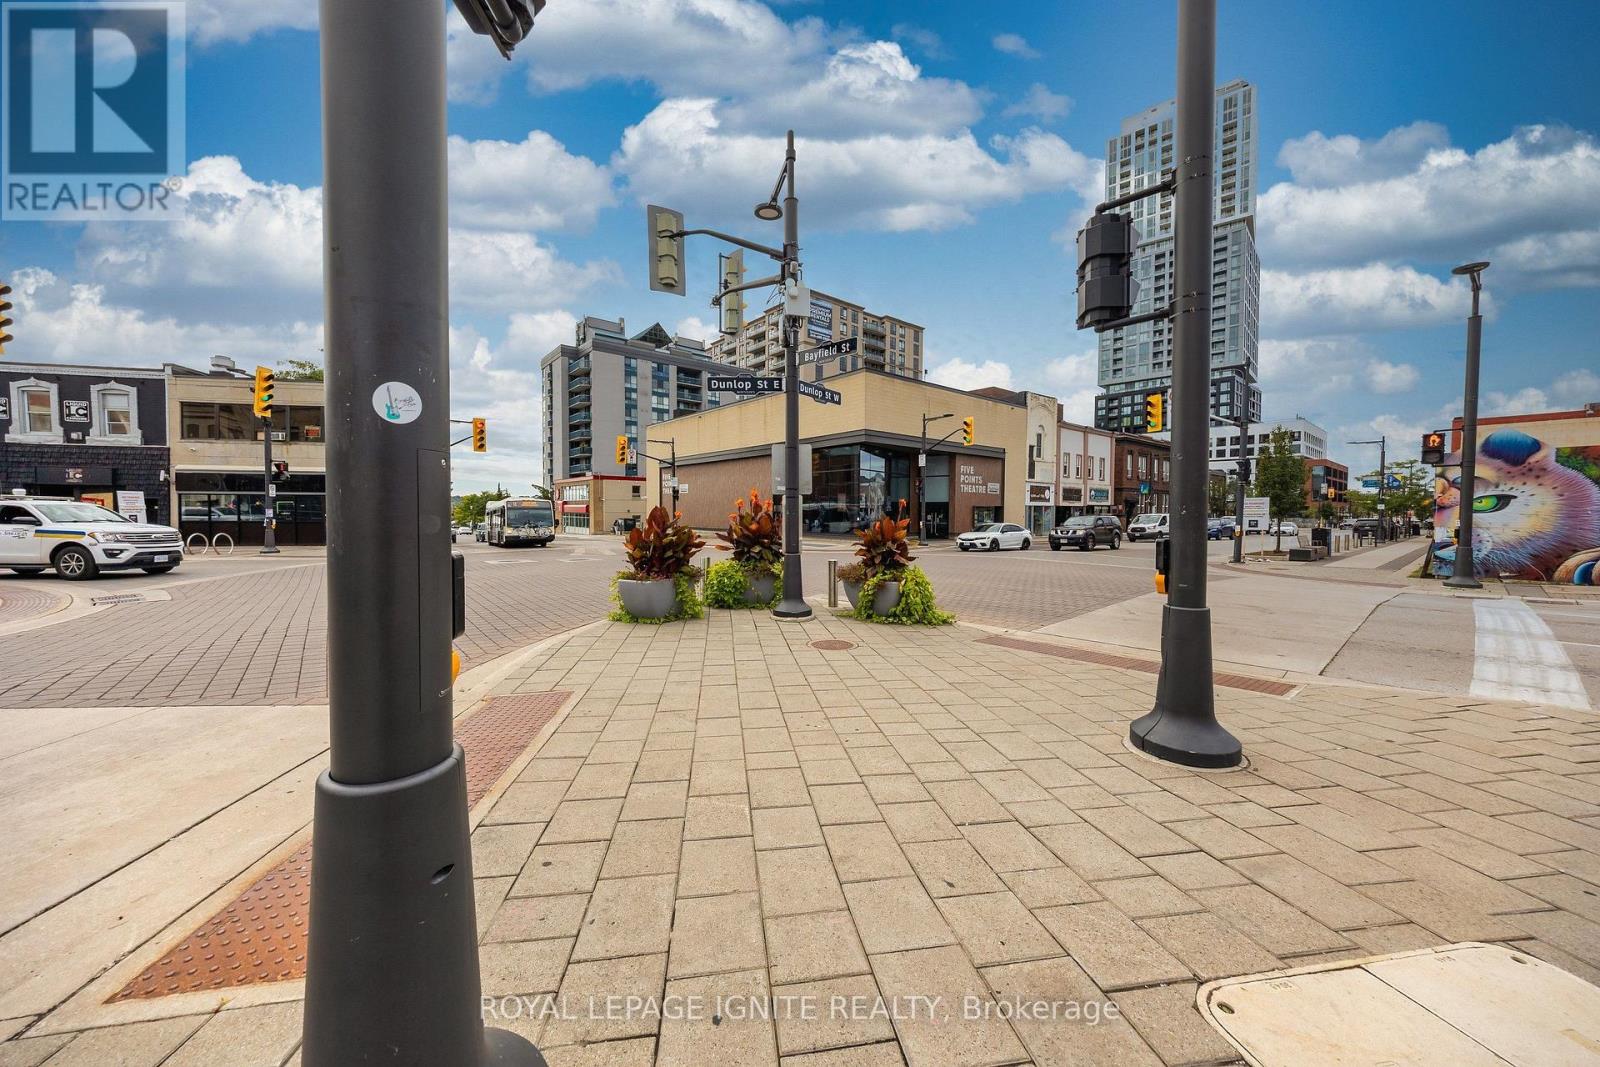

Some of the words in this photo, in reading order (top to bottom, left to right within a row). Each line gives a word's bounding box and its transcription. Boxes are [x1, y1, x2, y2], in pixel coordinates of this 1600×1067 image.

[804, 345, 837, 362] Bayfield
[841, 342, 850, 353] St
[711, 380, 752, 390] Dunlop
[757, 380, 768, 389] St
[773, 381, 780, 389] E
[800, 383, 823, 397] Dunlop
[825, 391, 832, 401] St
[834, 394, 840, 402] W
[960, 465, 975, 474] FIVE
[960, 475, 983, 484] POINTS
[960, 484, 987, 494] THEATRE
